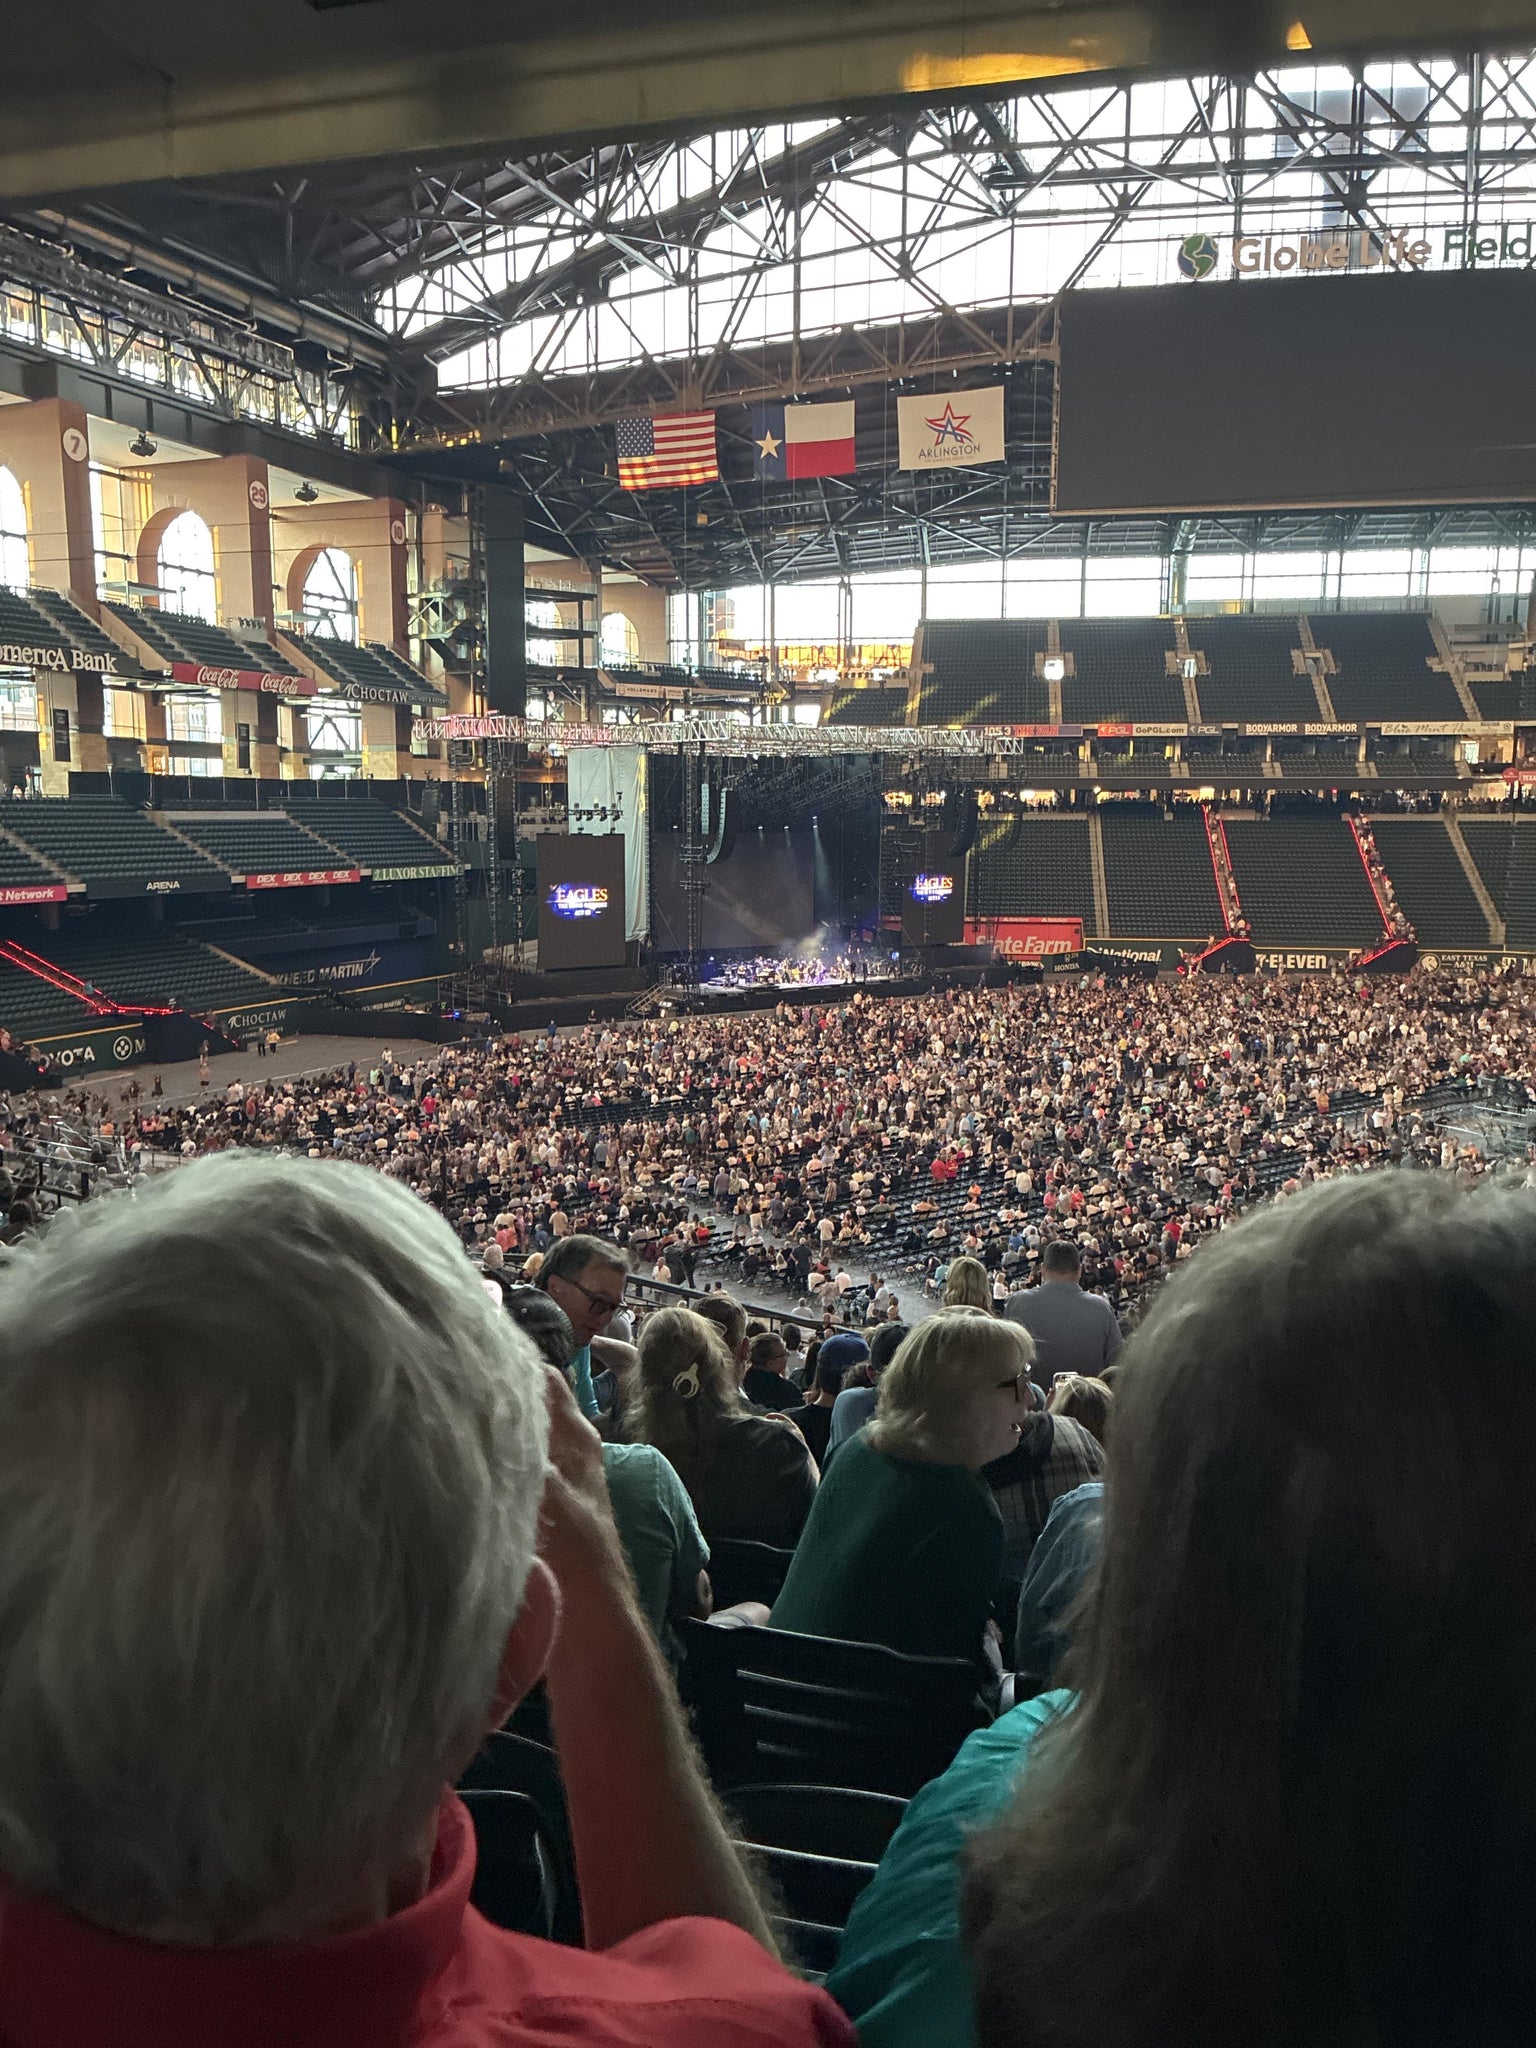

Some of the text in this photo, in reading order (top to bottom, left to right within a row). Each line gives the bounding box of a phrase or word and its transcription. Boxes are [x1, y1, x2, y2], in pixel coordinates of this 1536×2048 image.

[1232, 222, 1532, 272] Globe Life Field
[69, 435, 80, 455] 7
[918, 443, 981, 458] ARLINGTON
[251, 487, 265, 504] 29
[392, 524, 403, 540] 10
[71, 649, 118, 673] Bank
[351, 683, 409, 703] CHOCTAW
[1014, 725, 1034, 738] THE
[1107, 726, 1220, 736] PGL GoPGL.com PGL
[1246, 723, 1298, 733] BODYARMOR
[1304, 723, 1358, 733] BODYARMOR
[1383, 723, 1411, 735] Blue
[1413, 723, 1447, 734] Mint
[257, 873, 277, 884] DEX
[283, 872, 302, 883] DEX
[308, 870, 327, 881] DEX
[332, 869, 351, 880] DEX
[382, 866, 417, 881] LUXOR
[146, 881, 181, 892] ARENA
[5, 888, 54, 901] Network
[556, 887, 608, 902] EAGLES
[1441, 954, 1488, 962] EAST TEXAS
[319, 962, 364, 981] MARTIN
[1054, 962, 1080, 973] HONDA
[234, 1008, 287, 1028] CHOCTAW
